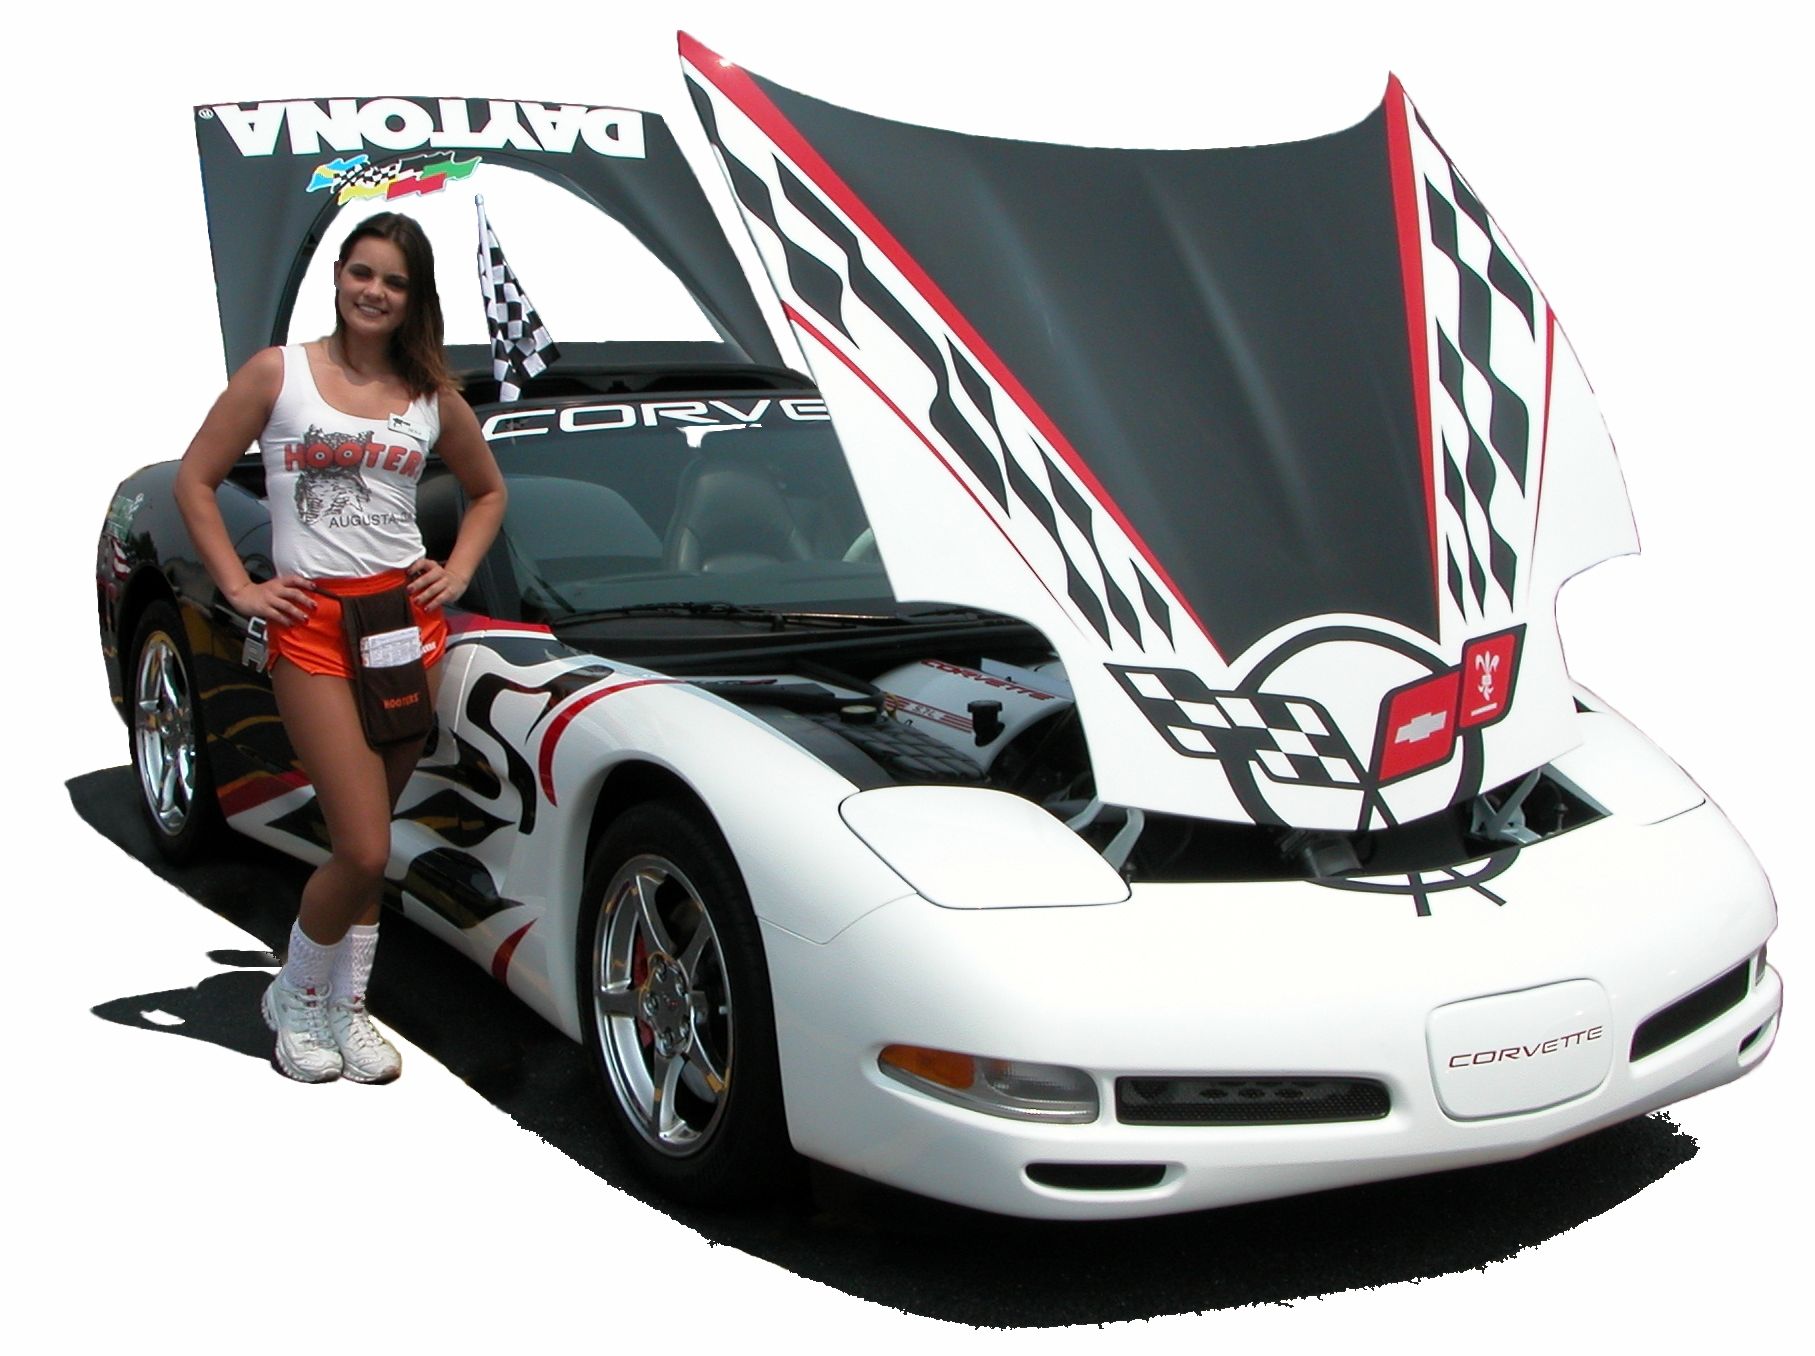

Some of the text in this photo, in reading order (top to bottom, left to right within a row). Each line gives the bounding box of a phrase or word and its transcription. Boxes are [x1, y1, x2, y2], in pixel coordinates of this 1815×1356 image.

[212, 99, 646, 159] DAYTONA
[329, 513, 396, 528] AUGUSTA
[921, 658, 1055, 701] CORVETTE
[1449, 1025, 1603, 1068] CORVETTE
